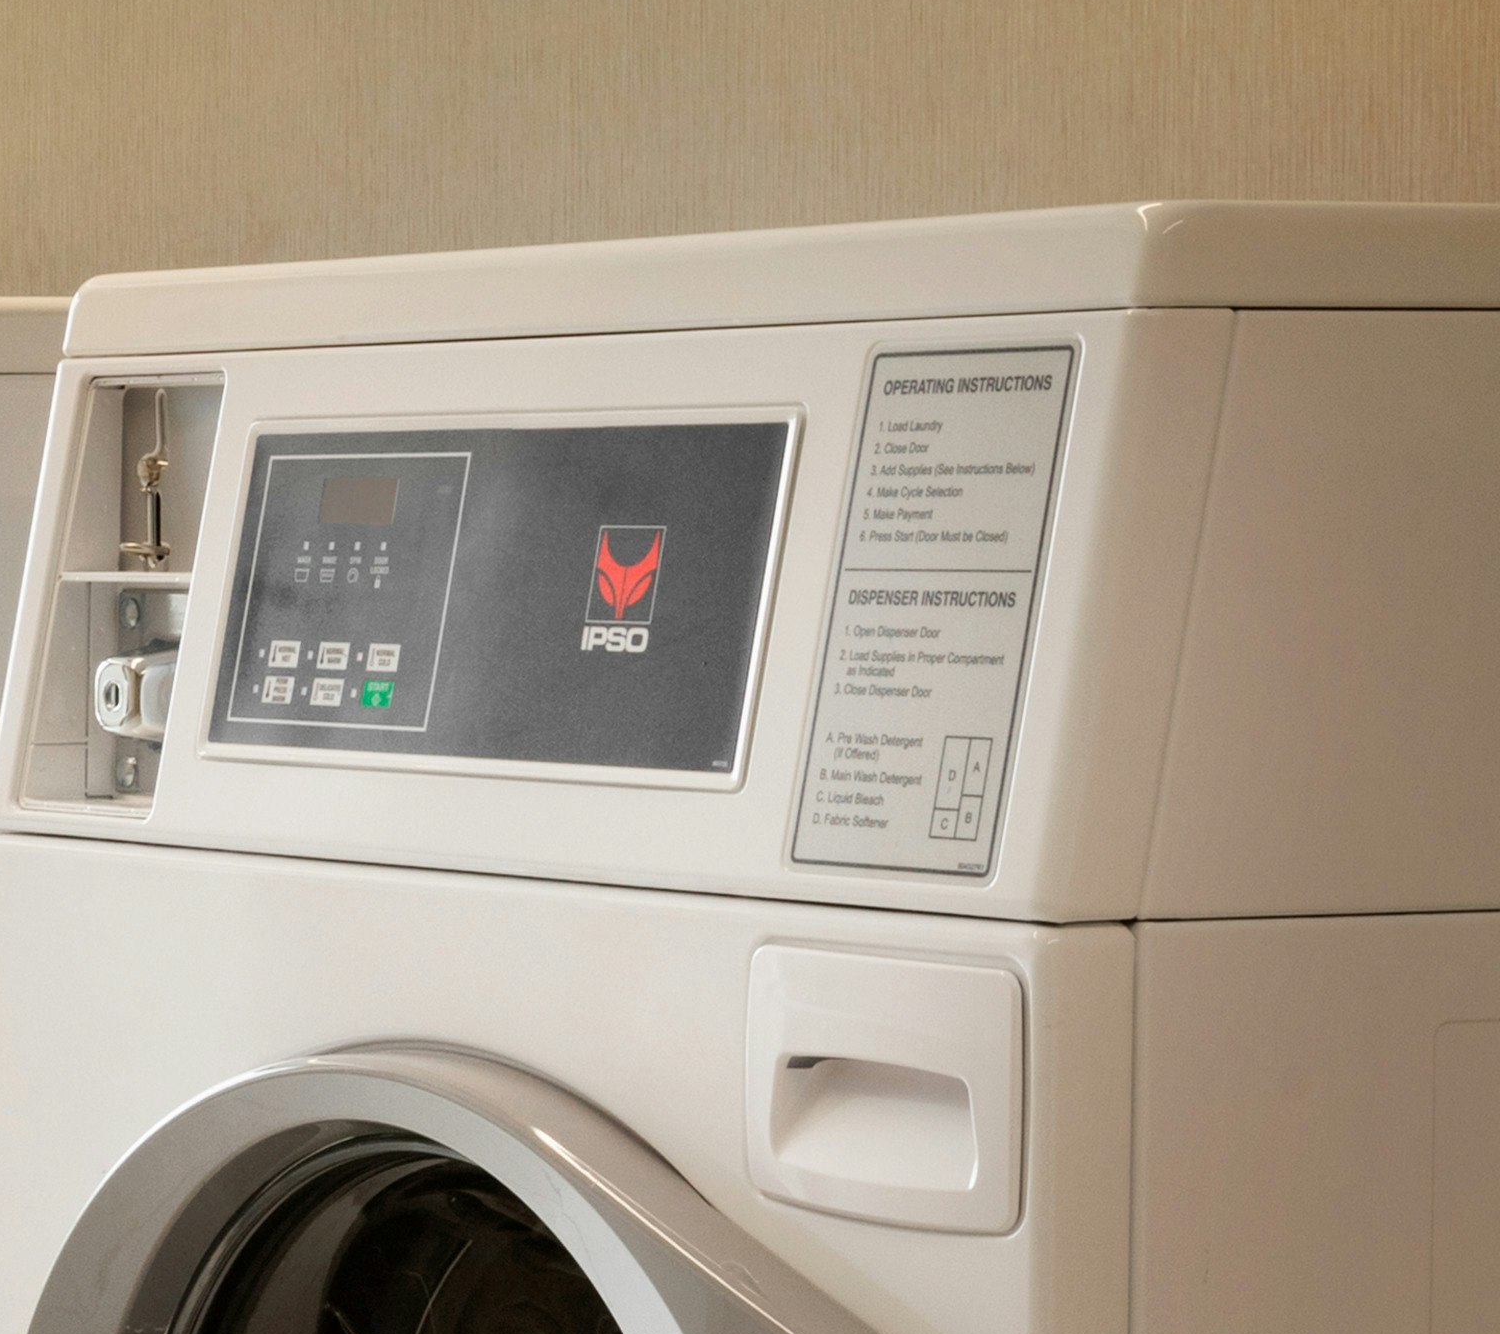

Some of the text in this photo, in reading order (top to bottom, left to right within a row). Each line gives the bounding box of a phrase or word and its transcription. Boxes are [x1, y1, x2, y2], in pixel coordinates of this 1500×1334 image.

[883, 374, 1053, 396] OPERATING INSTRUCTIONS
[887, 421, 909, 433] Load
[909, 419, 944, 435] Laundry
[884, 442, 908, 455] Close
[909, 442, 930, 454] Door
[879, 464, 897, 476] Add
[899, 464, 933, 478] Supplies
[956, 462, 1005, 475] Instructions
[1006, 462, 1036, 477] Below)
[876, 486, 899, 498] Make
[900, 486, 924, 500] Cycle
[925, 485, 963, 498] Selection
[873, 508, 896, 520] Make
[897, 508, 933, 522] Payment
[869, 530, 893, 542] Press
[894, 530, 915, 542] Start
[941, 530, 961, 542] Must
[962, 530, 974, 542] be
[975, 530, 1009, 544] Closed)
[848, 589, 1017, 608] DISPENSER INSTRUCTIONS
[580, 625, 650, 653] IPSO
[853, 625, 876, 638] Open
[877, 625, 919, 639] Dispenser
[920, 626, 942, 639] Door
[850, 649, 870, 662] Load
[871, 650, 906, 664] Supplies
[917, 651, 947, 665] Proper
[947, 651, 1005, 666] Compartment
[858, 665, 896, 677] Indicated
[844, 683, 868, 696] Close
[868, 683, 911, 698] Dispenser
[911, 685, 933, 698] Door
[854, 734, 879, 745] Wash
[880, 735, 924, 750] Detergent
[972, 761, 981, 773] A
[831, 769, 852, 781] Main
[853, 770, 878, 782] Wash
[879, 771, 923, 787] Detergent
[948, 770, 957, 782] D
[827, 792, 853, 805] Liquid
[854, 793, 885, 806] Bleach
[824, 813, 851, 826] Fabric
[852, 815, 890, 829] Softener
[940, 818, 949, 830] C
[964, 812, 973, 824] B
